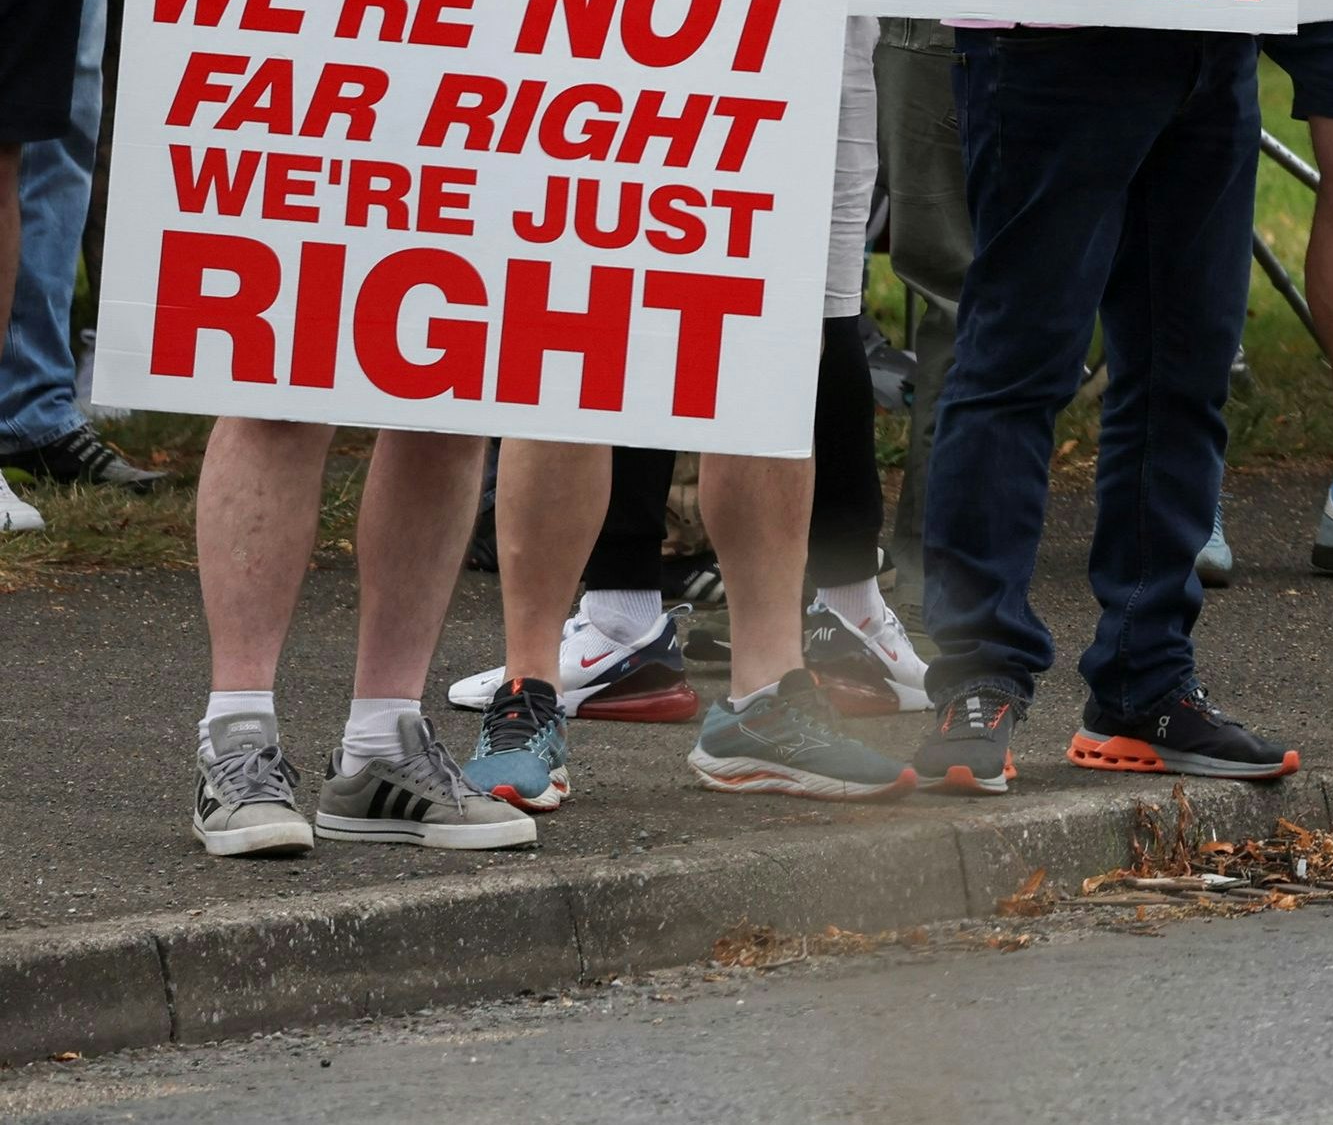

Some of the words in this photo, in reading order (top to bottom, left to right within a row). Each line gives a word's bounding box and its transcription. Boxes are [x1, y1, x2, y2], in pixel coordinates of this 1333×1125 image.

[165, 52, 389, 142] FAR
[417, 73, 787, 173] RIGHT
[169, 144, 477, 236] WE'RE
[512, 176, 774, 258] JUST
[150, 229, 765, 419] RIGHT
